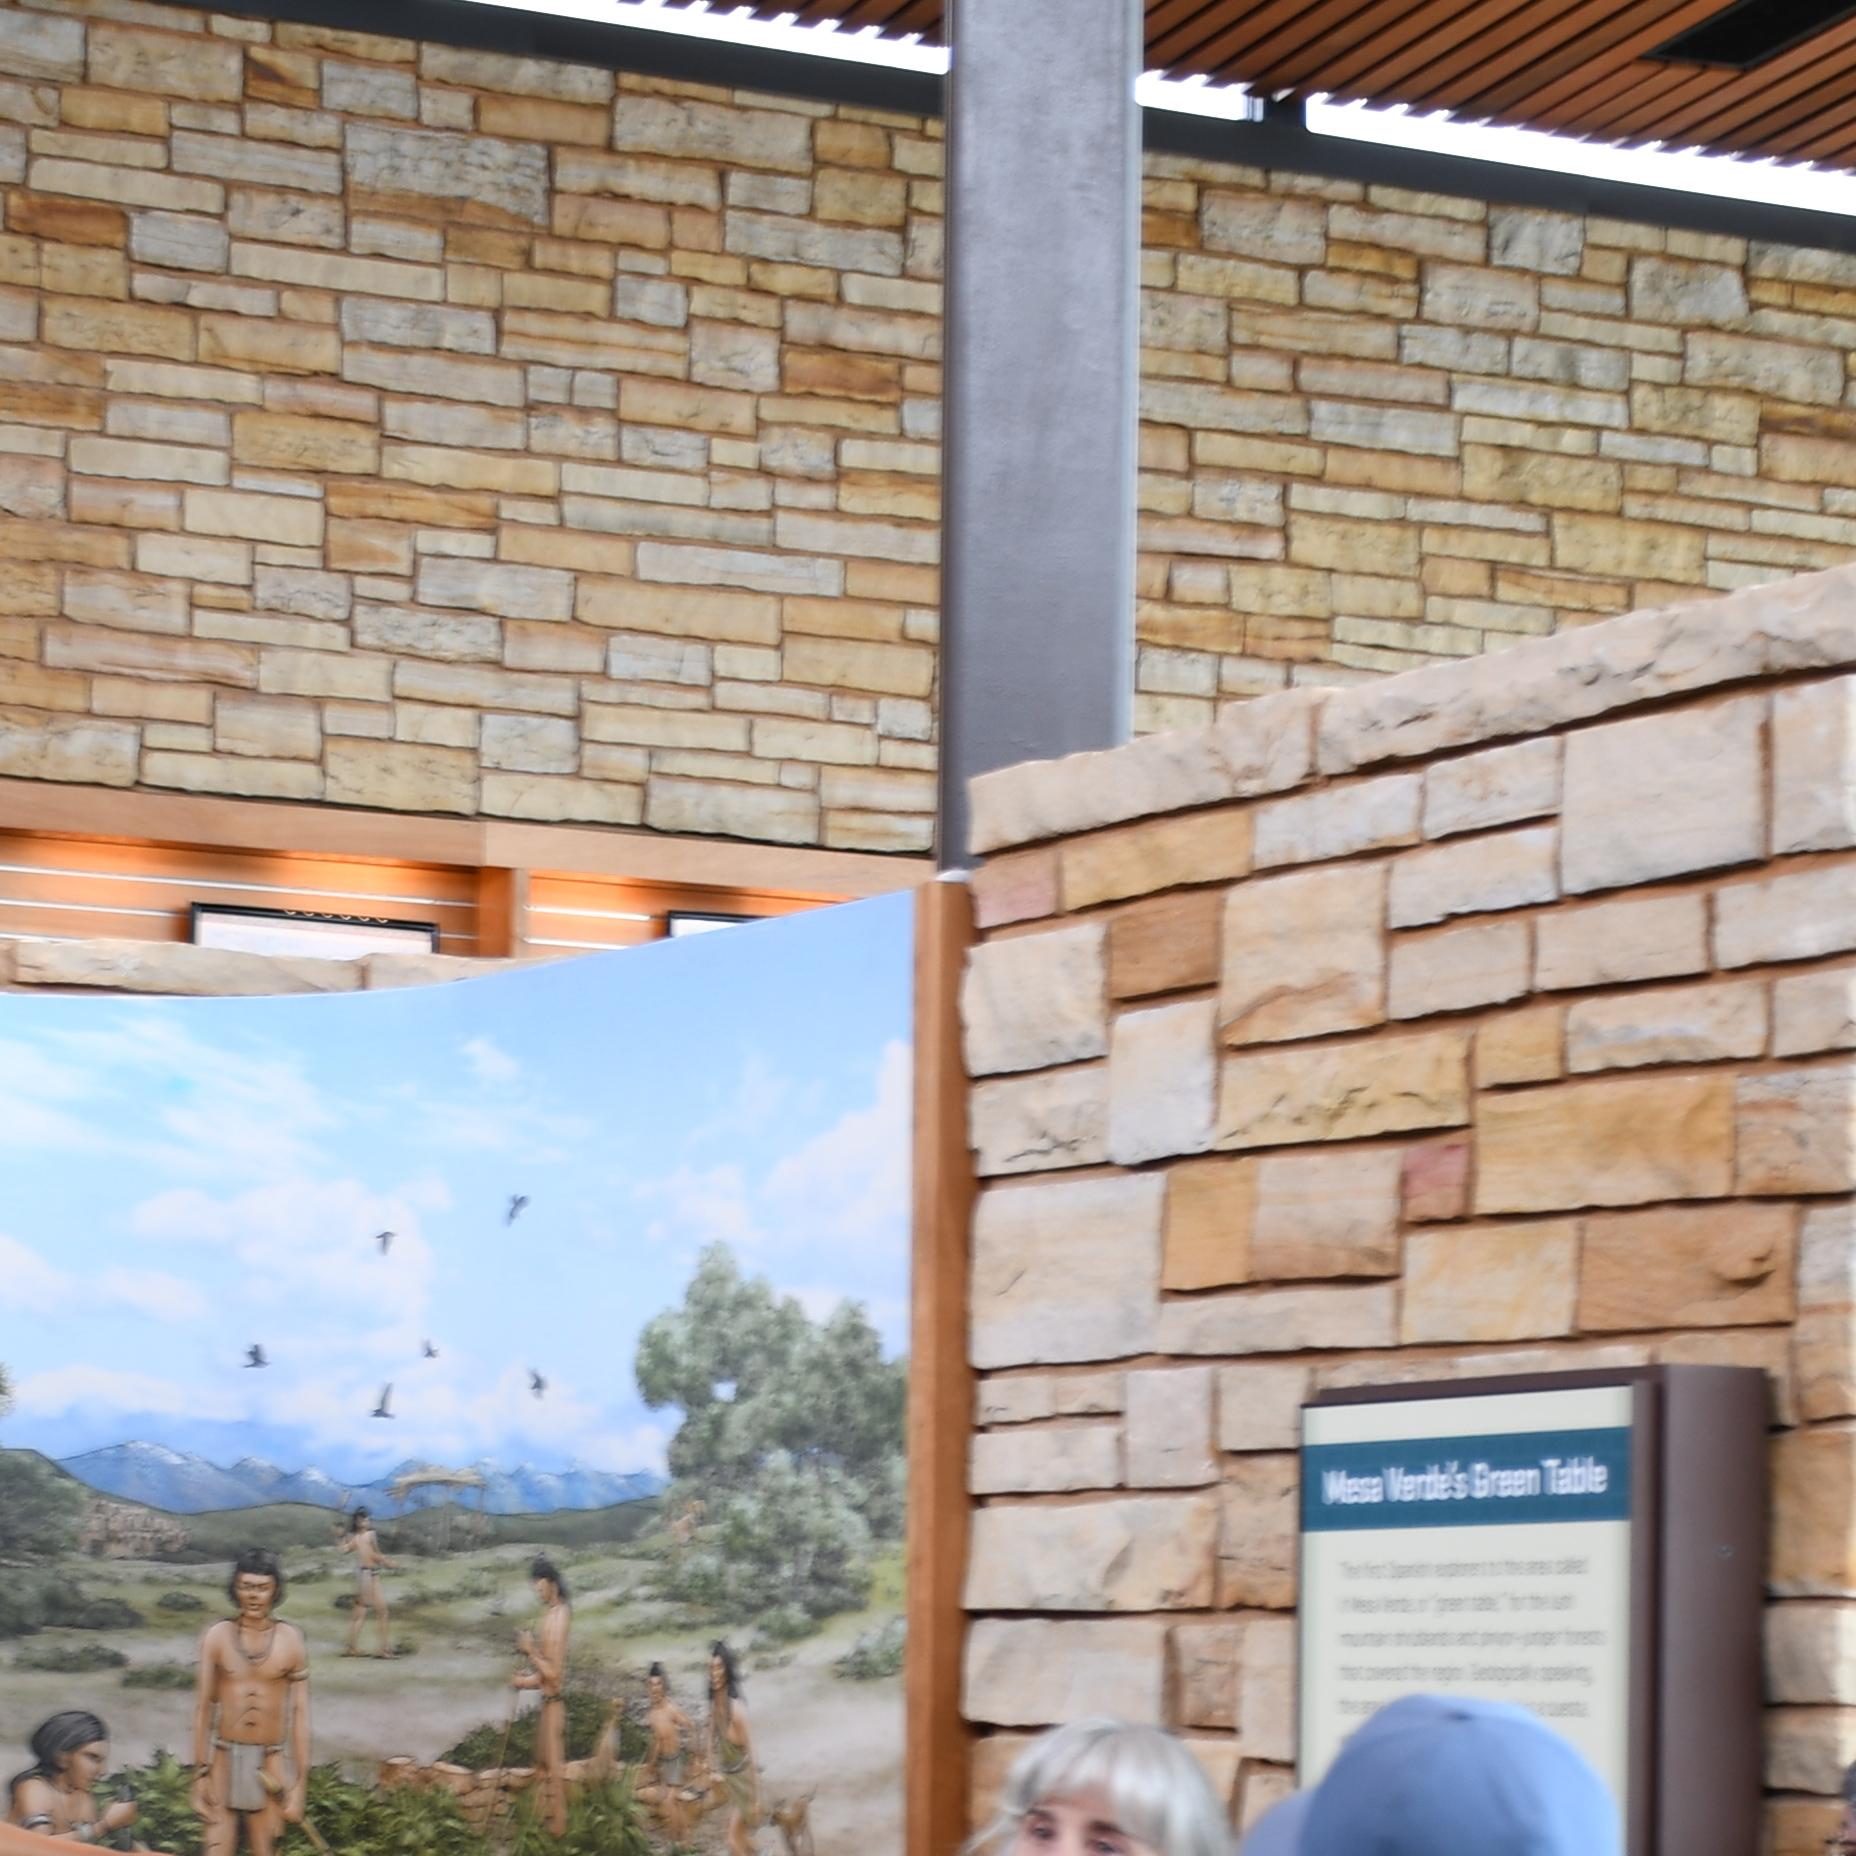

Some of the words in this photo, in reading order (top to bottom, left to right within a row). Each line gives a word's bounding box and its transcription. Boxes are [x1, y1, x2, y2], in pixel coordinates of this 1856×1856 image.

[1322, 1469, 1383, 1505] Mesa
[1383, 1460, 1468, 1502] Verde's
[1467, 1461, 1541, 1499] Green
[1541, 1455, 1608, 1495] Table
